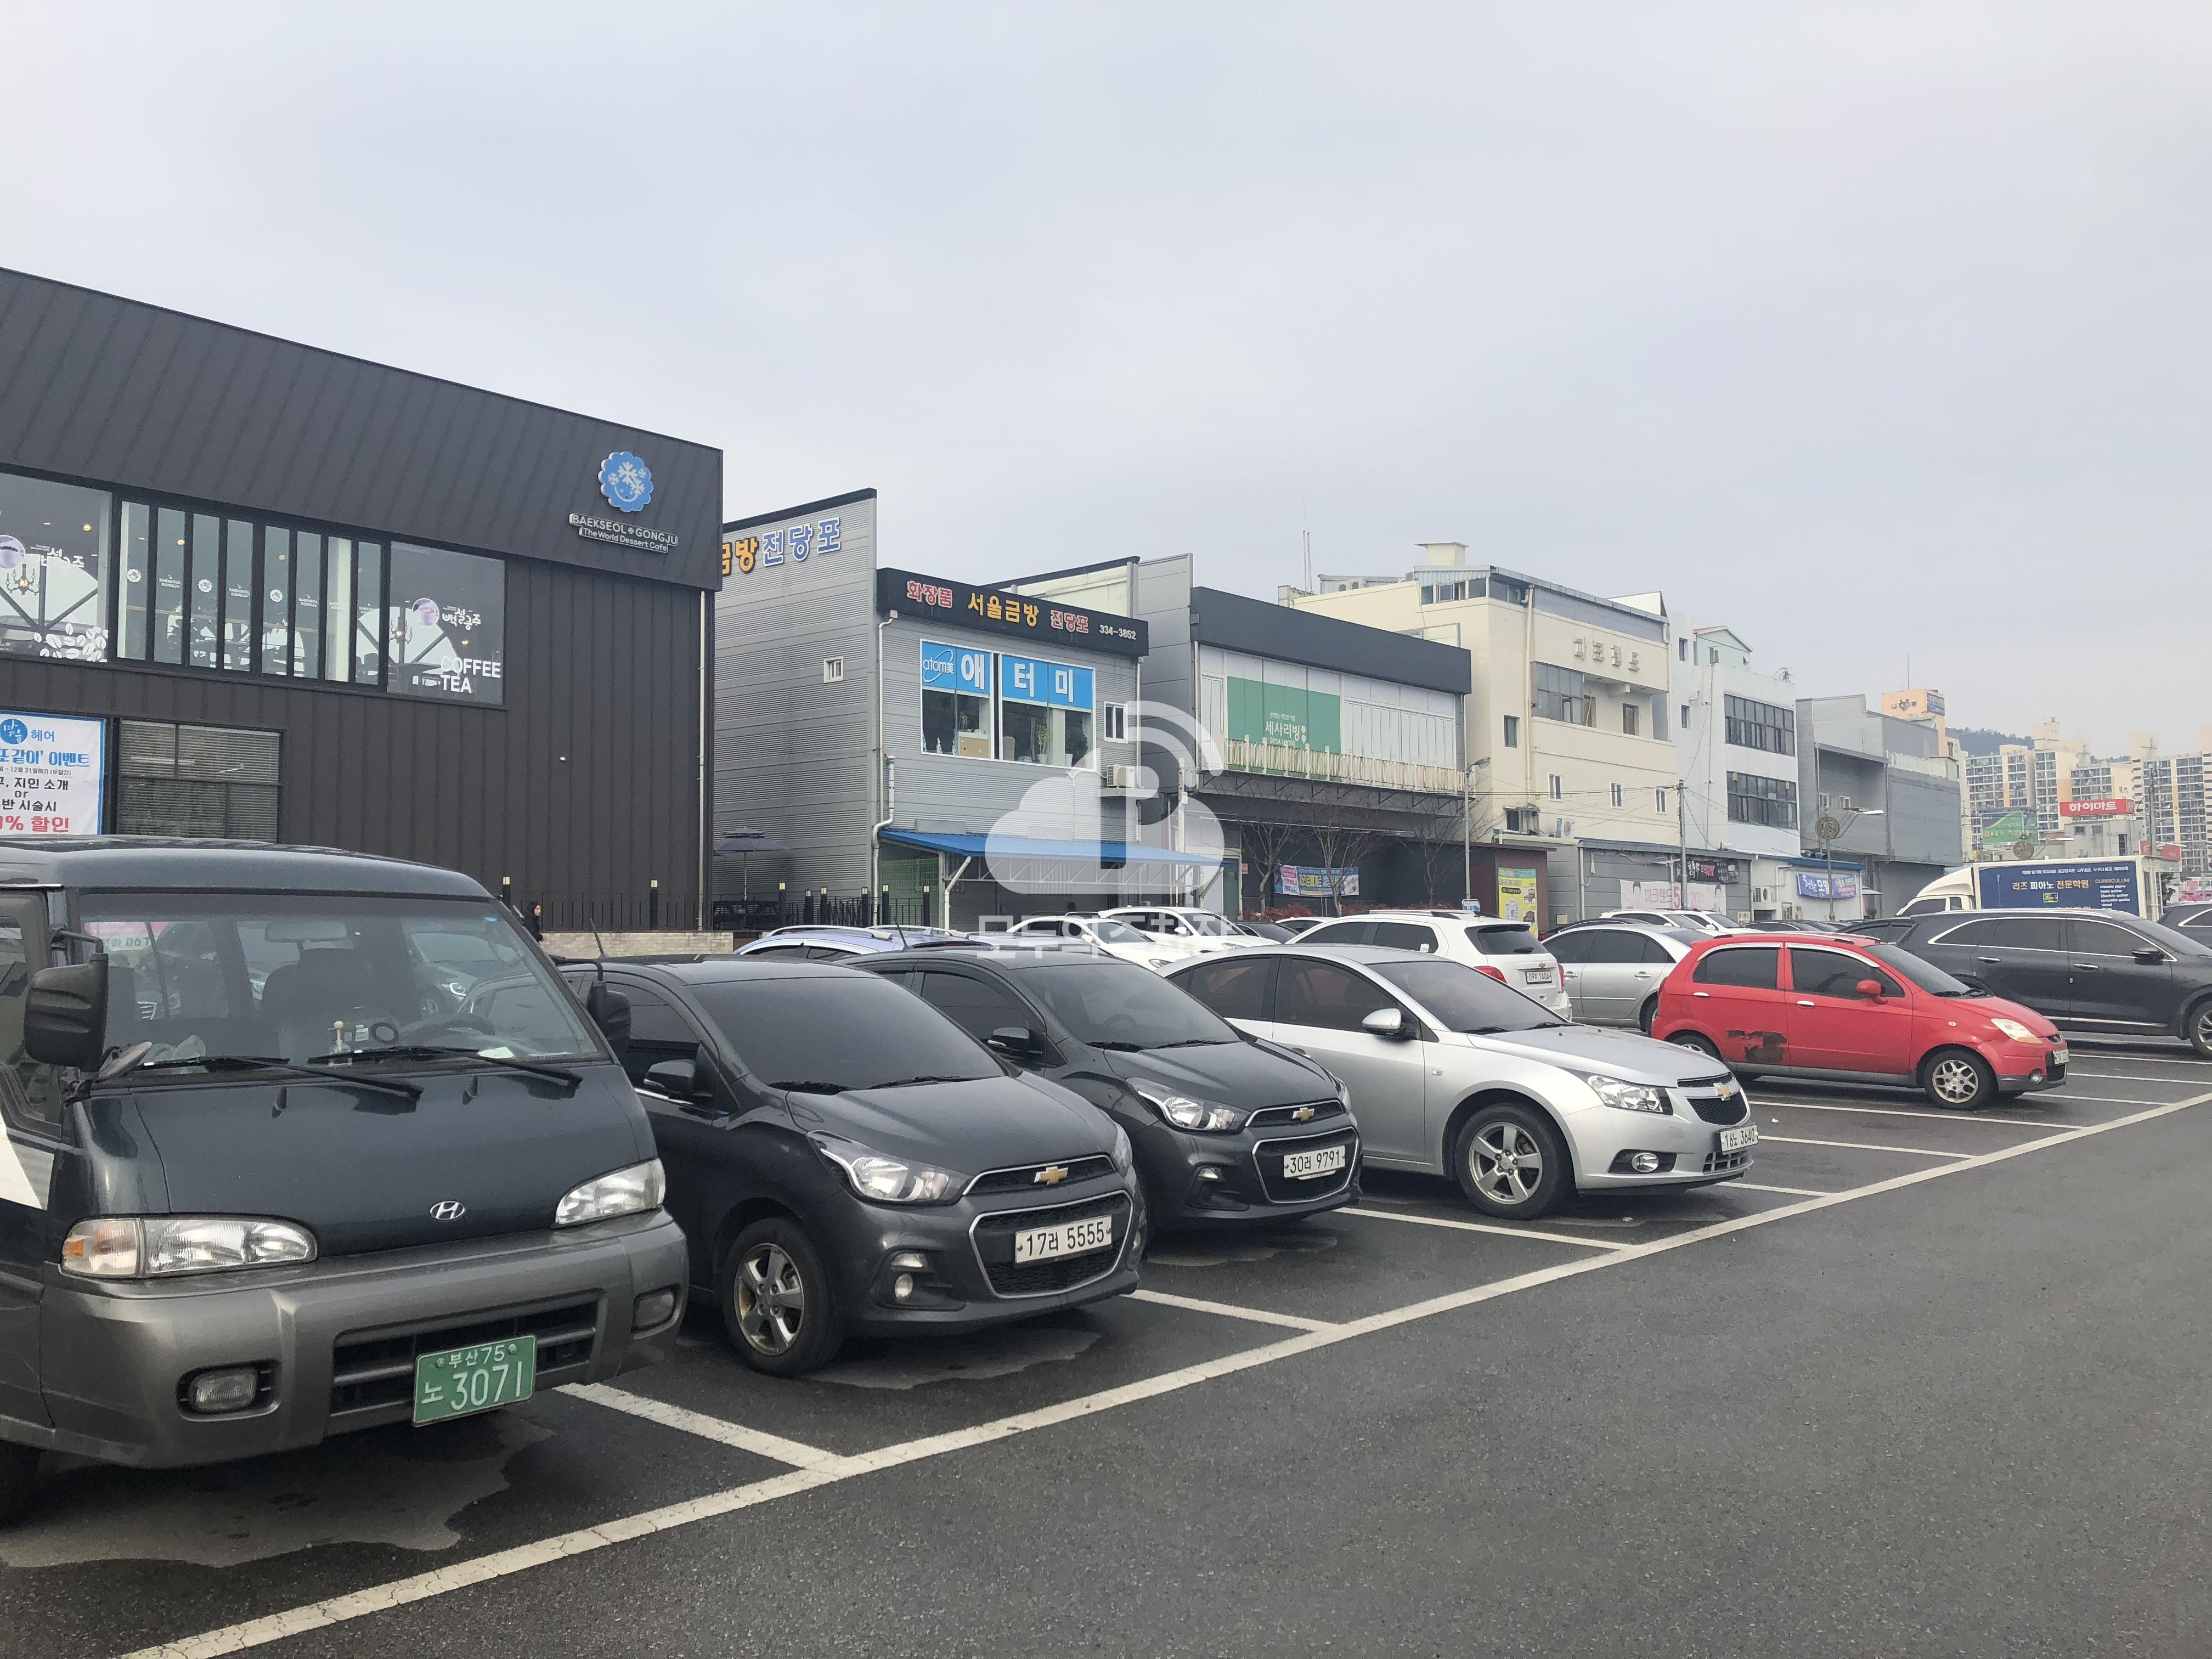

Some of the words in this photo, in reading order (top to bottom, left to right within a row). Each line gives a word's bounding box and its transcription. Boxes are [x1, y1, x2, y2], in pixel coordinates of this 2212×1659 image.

[573, 514, 627, 535] BAEKSEOL
[635, 528, 678, 545] GONGJU
[583, 527, 597, 537] The
[597, 531, 619, 541] World
[619, 535, 648, 548] Dessert
[649, 541, 667, 551] Cafe
[762, 517, 841, 567] 전당포
[906, 580, 953, 608] 화장품
[968, 592, 1040, 627] 서울금방
[1050, 610, 1090, 634] 전당포
[1099, 624, 1137, 640] 334-3852
[1573, 637, 1641, 672] 파크랜드
[441, 656, 501, 679] COFFEE
[440, 674, 472, 694] TEA
[961, 654, 1074, 703] 애터미
[31, 729, 55, 742] 헤어
[1265, 721, 1300, 742] 세사리빙
[48, 751, 89, 768] 이벤트
[14, 777, 39, 789] 지인
[43, 779, 69, 791] 소개
[14, 790, 29, 798] or
[2, 799, 15, 810] 반
[19, 800, 57, 812] 시술시
[2069, 801, 2117, 812] 하이마트
[31, 816, 69, 833] 할인
[2012, 882, 2028, 890] 리즈
[2030, 881, 2055, 890] 피아노
[2056, 879, 2090, 889] 전문학원
[1724, 1132, 1738, 1148] 16노
[1741, 1127, 1755, 1145] 3640
[1290, 1155, 1311, 1173] 30러
[1316, 1149, 1339, 1170] 9791
[1026, 1232, 1059, 1257] 17러
[1067, 1221, 1104, 1250] 5555
